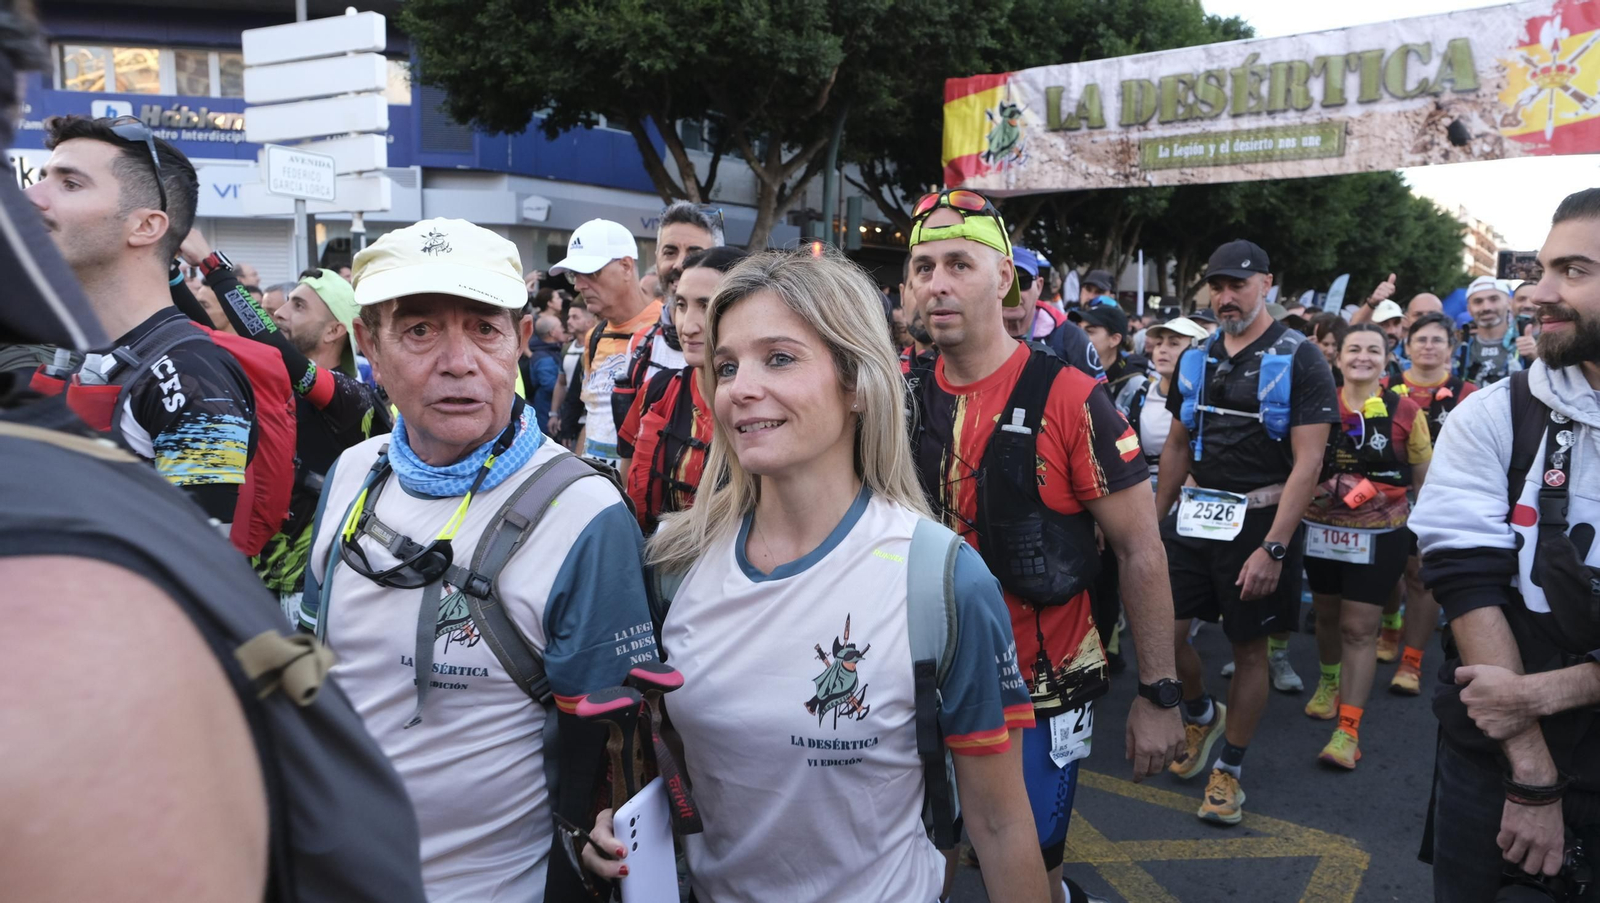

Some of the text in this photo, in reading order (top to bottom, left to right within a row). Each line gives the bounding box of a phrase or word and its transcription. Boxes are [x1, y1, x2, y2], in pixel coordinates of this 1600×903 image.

[1045, 37, 1480, 132] LA DESÉRTICA
[1158, 134, 1322, 159] La Legión y el desierto nos une
[288, 155, 332, 169] AVENIDA
[282, 166, 322, 183] FEDERICO
[304, 182, 331, 197] LORCA
[1192, 502, 1237, 522] 2526
[1321, 528, 1360, 548] 1041
[614, 629, 629, 642] LA
[615, 644, 630, 656] EL
[629, 651, 653, 666] NOS
[400, 655, 490, 678] LA SÉRTICA
[790, 734, 880, 751] LA DESÉRTICA
[807, 757, 864, 768] VI EDICIÓN
